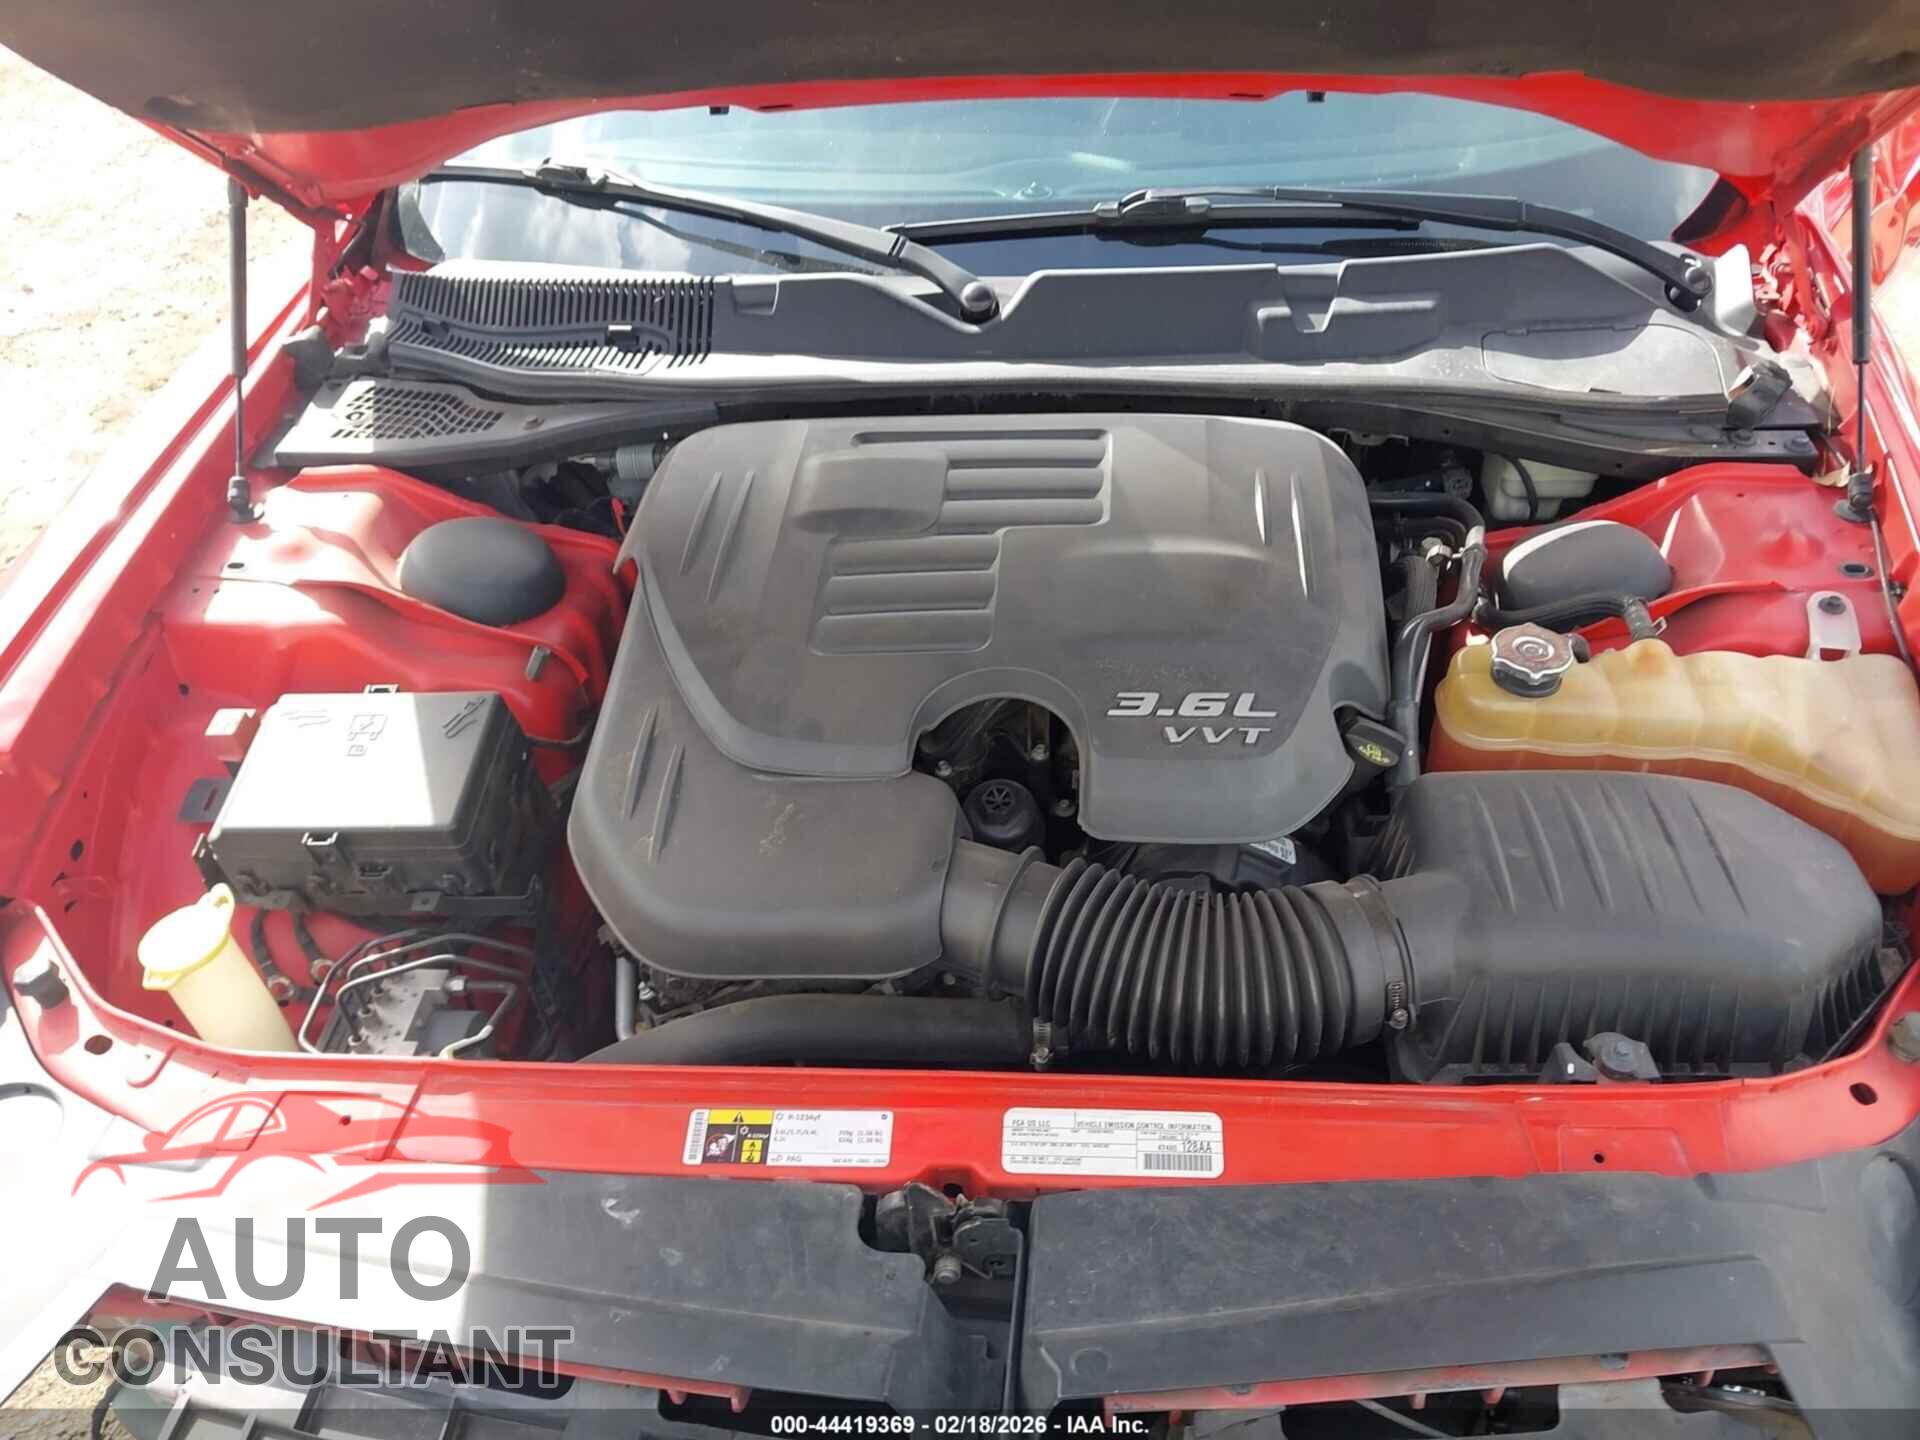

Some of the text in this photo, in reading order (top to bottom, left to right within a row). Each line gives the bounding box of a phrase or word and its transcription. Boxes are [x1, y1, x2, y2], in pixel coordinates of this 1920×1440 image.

[1107, 692, 1277, 717] 3.6L
[1163, 726, 1272, 744] VVT
[1077, 1121, 1212, 1131] VEHICLE EMISSION CONTROL INFORMATION
